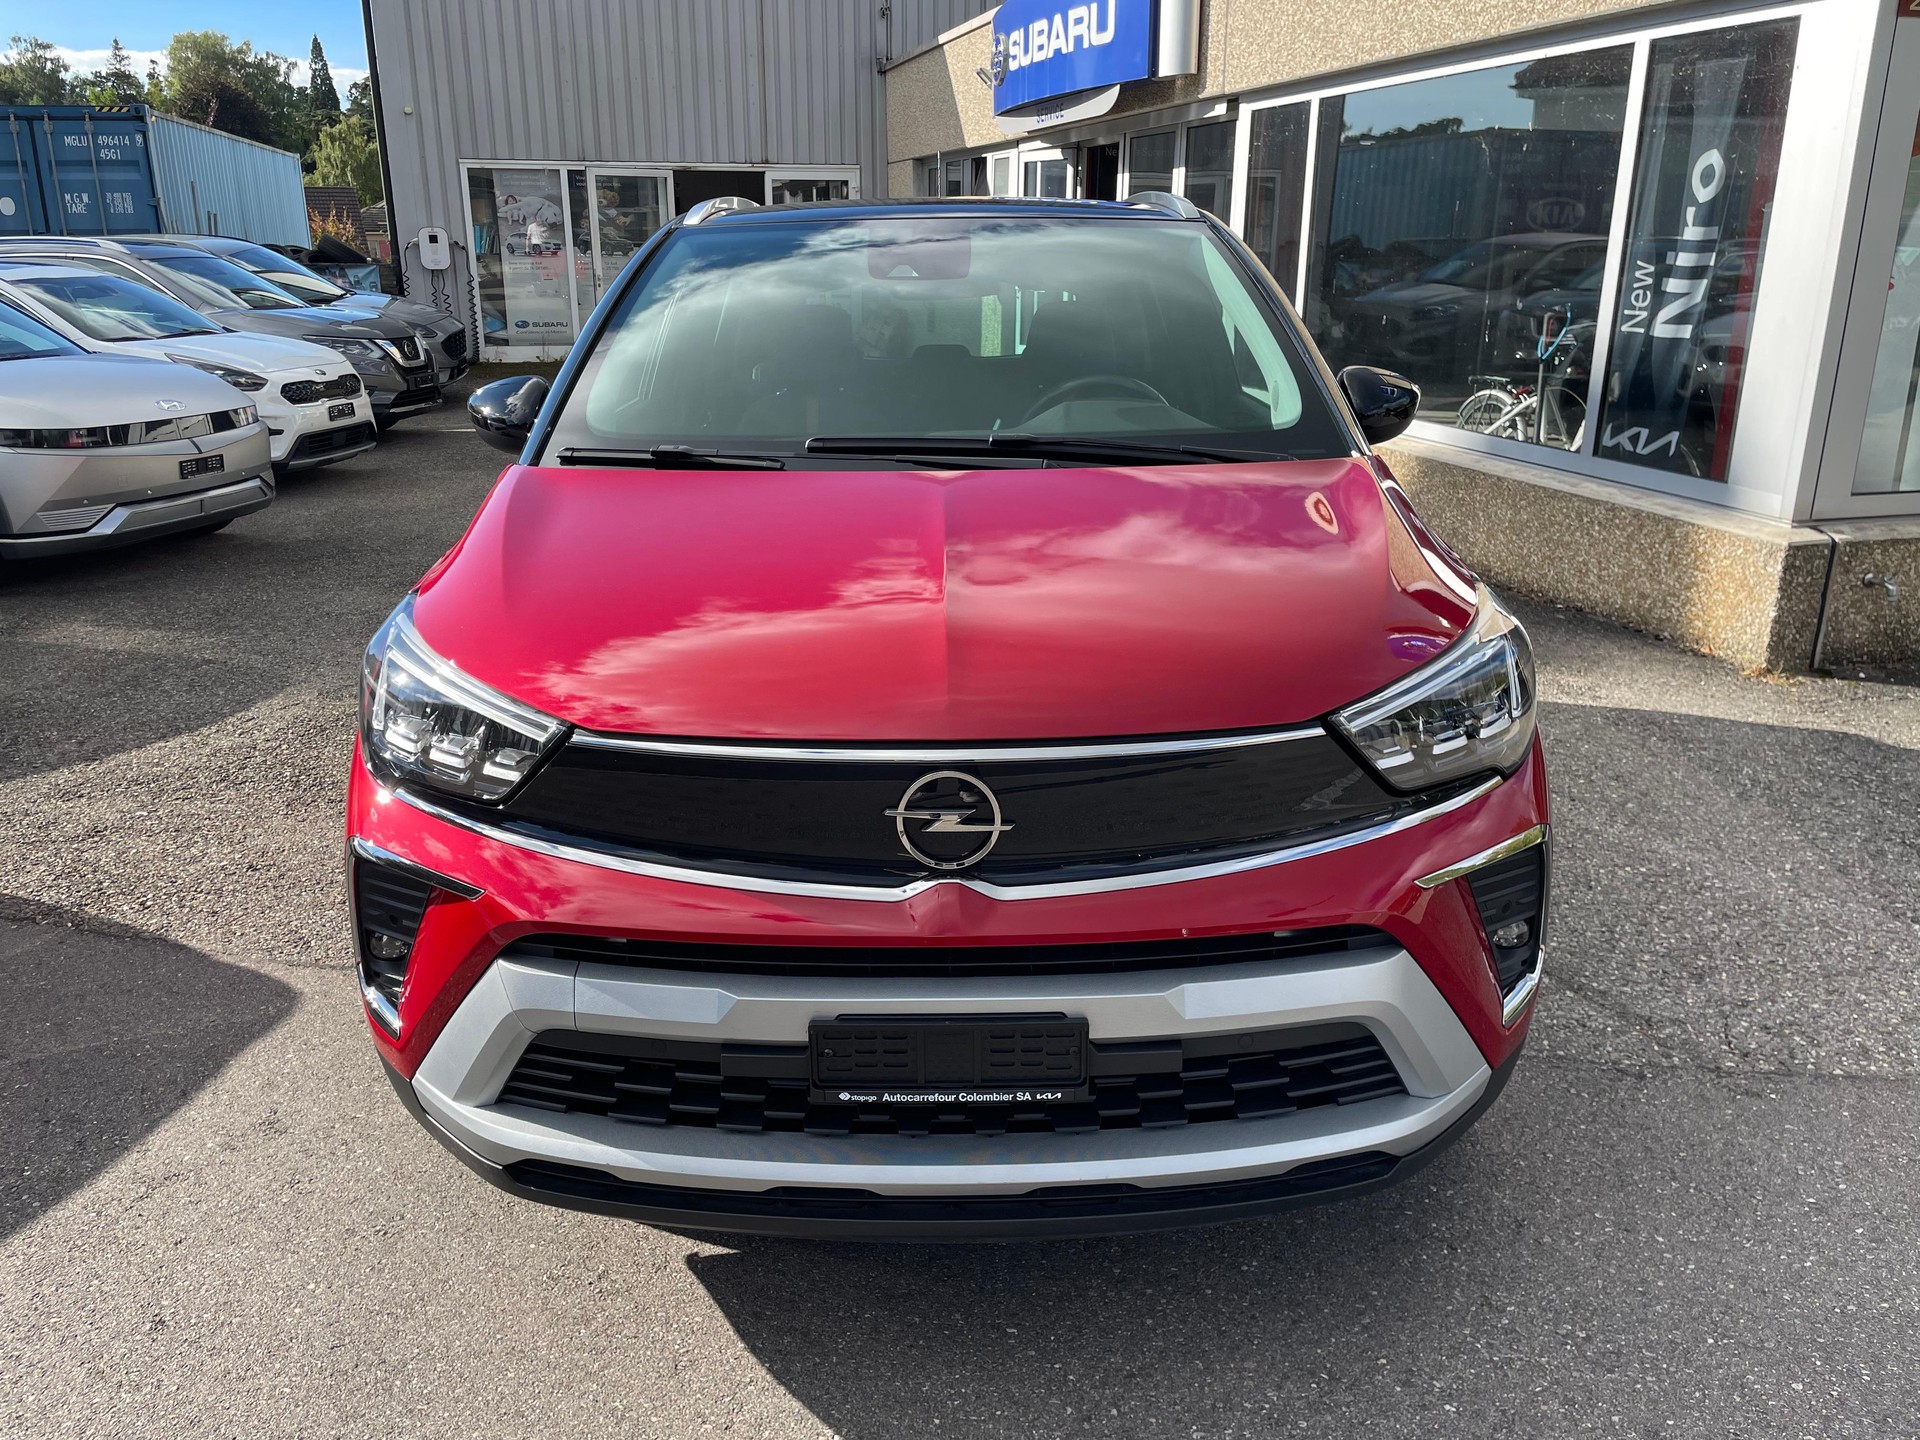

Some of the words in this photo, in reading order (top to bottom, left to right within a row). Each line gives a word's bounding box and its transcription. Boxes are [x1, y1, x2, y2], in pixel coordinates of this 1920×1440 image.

[1008, 0, 1116, 71] SUBARU
[1036, 103, 1064, 123] SERVICE
[64, 135, 88, 147] MGLU
[97, 135, 130, 147] 496414
[136, 134, 143, 147] 9
[100, 148, 121, 160] 45G1
[66, 203, 88, 214] TARE
[1649, 148, 1727, 339] Niro
[1620, 260, 1656, 335] New
[882, 1092, 956, 1102] Autocarrefour
[958, 1092, 1014, 1102] Colombier
[1016, 1092, 1032, 1101] SA
